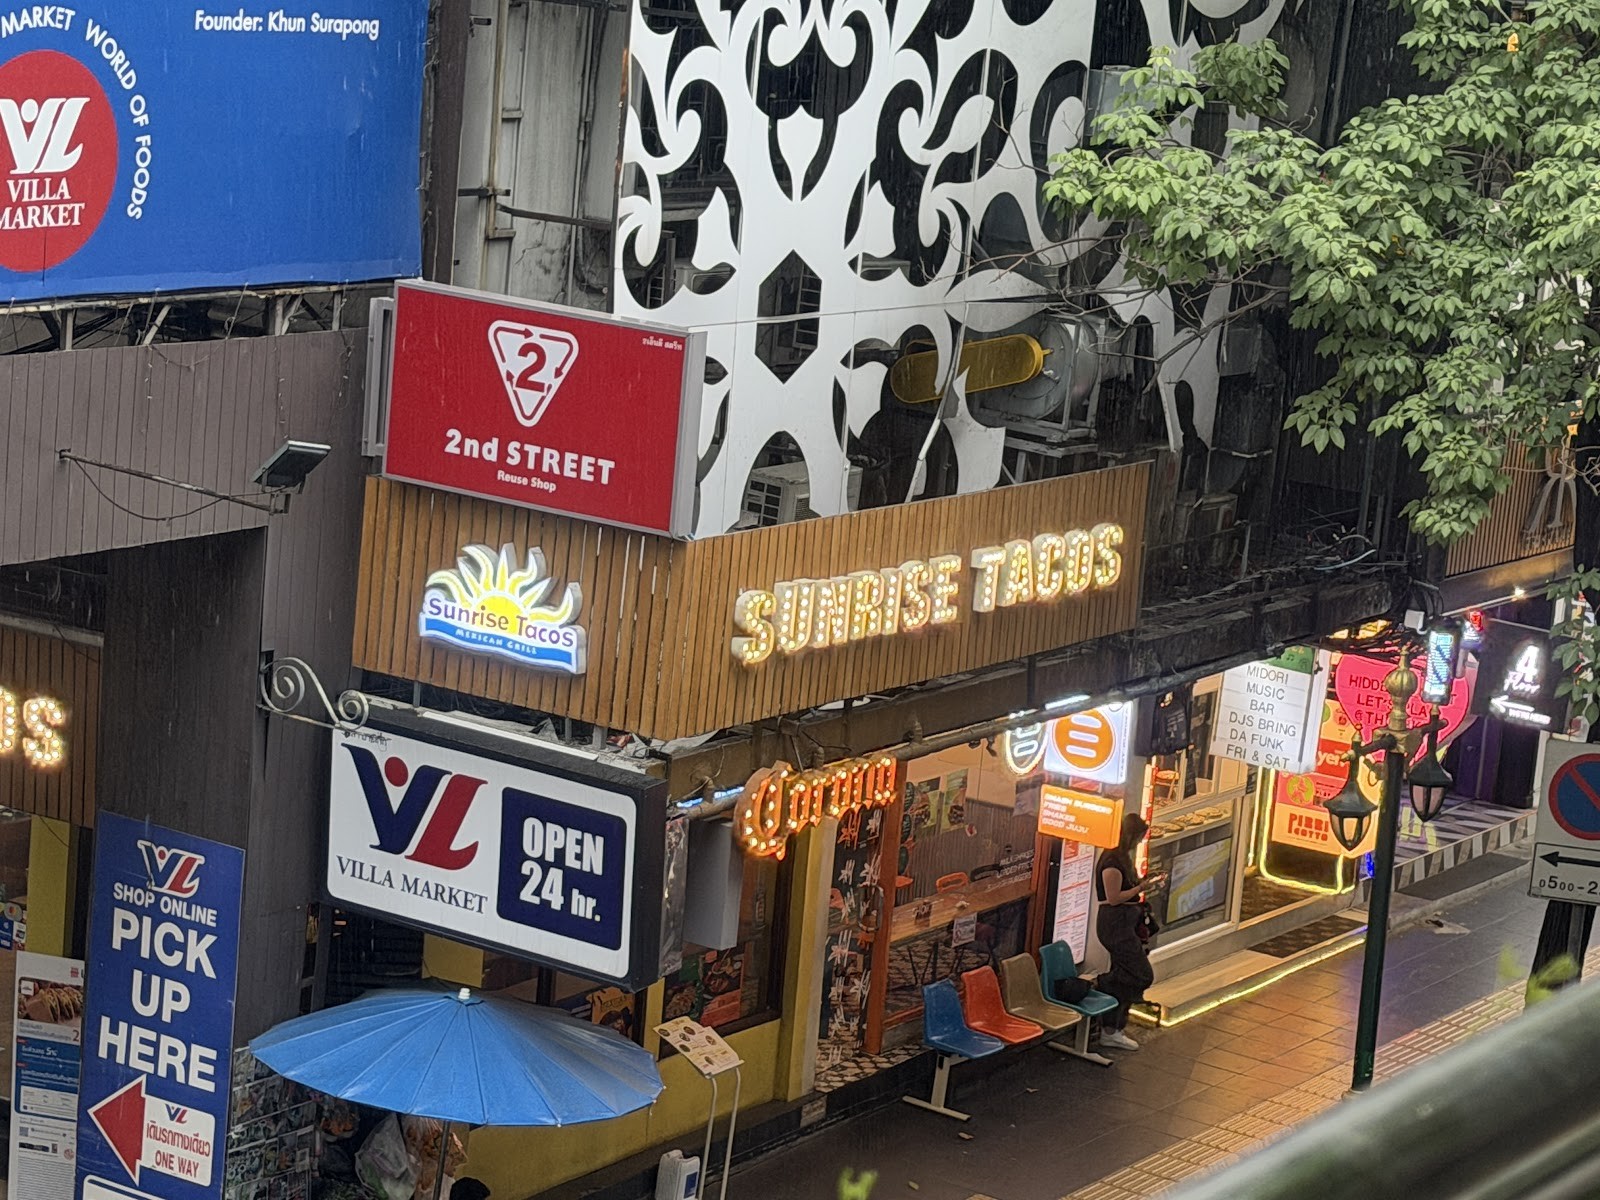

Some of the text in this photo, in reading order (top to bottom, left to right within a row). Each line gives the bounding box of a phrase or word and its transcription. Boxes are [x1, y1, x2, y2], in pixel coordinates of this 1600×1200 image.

[194, 9, 380, 40] Founder: Khun Surapong
[1, 5, 152, 220] MARKET WORLD OF FOODS
[6, 176, 72, 203] VILLA
[444, 428, 615, 485] 2nd STREET
[497, 470, 557, 493] Reuse Shop
[731, 522, 1124, 665] SUNRISE TACOS
[428, 597, 574, 647] Sunrise Tacos
[455, 628, 537, 655] MEXICAN GRILL
[1246, 666, 1289, 686] MIDORI
[1516, 645, 1540, 682] 4
[1246, 682, 1285, 701] MUSIC
[1249, 699, 1275, 715] BAR
[1229, 711, 1296, 737] DJS BRING
[1229, 728, 1285, 751] DA FUNK
[1226, 744, 1290, 769] FRI & SAT
[1065, 823, 1090, 834] JUJU
[522, 816, 604, 876] OPEN
[336, 855, 488, 915] VILLA MARKET
[519, 860, 601, 922] 24 hr.
[113, 882, 218, 928] SHOP ONLINE
[112, 907, 218, 979] PICK
[131, 969, 191, 1023] UP
[98, 1015, 218, 1093] HERE
[155, 1149, 200, 1179] ONE WAY
